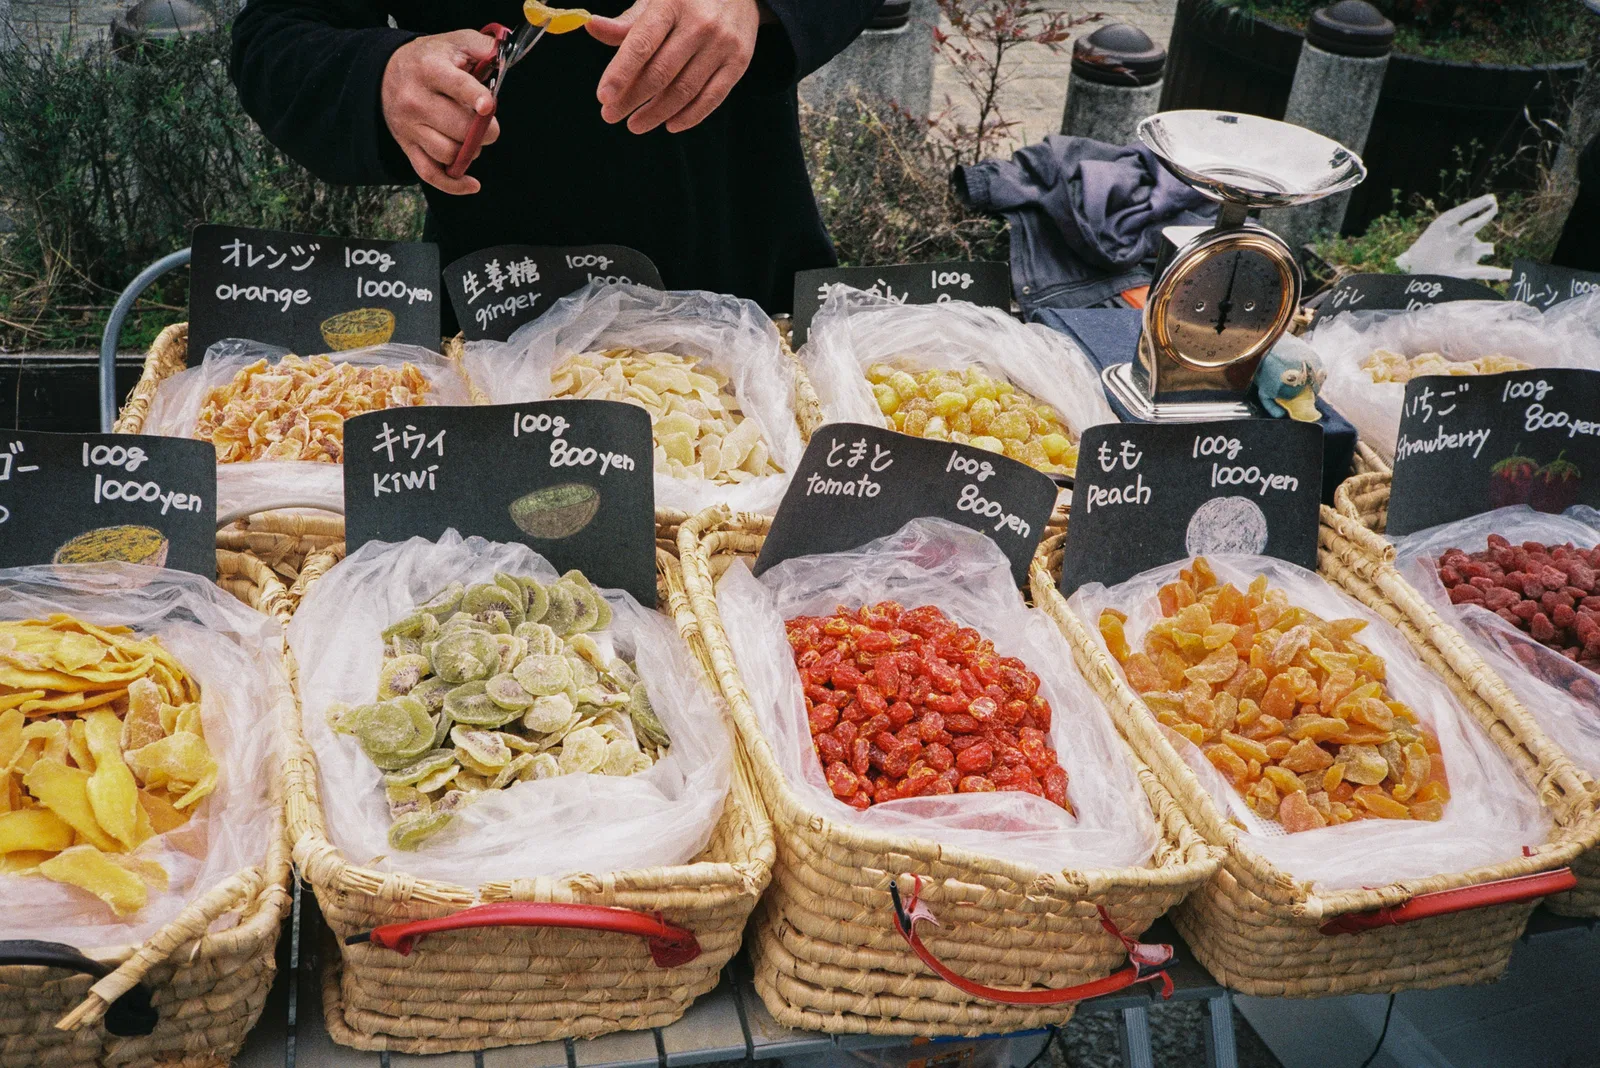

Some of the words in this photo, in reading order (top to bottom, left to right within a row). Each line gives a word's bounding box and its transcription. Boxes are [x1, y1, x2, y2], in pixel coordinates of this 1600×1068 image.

[220, 238, 320, 271] オレンジ
[344, 247, 396, 272] 100g
[565, 255, 614, 271] 100g
[462, 256, 540, 304] 生姜糖
[931, 270, 974, 289] 100g
[1404, 279, 1443, 299] 100g
[1513, 272, 1559, 306] プルーン
[215, 283, 311, 312] orange
[475, 292, 542, 331] ginger
[1332, 286, 1365, 308] なし
[1405, 382, 1470, 423] いちご
[1502, 379, 1554, 403] 100g
[513, 412, 570, 437] 100g
[82, 442, 148, 472] 100g
[826, 438, 893, 472] とまと
[1097, 440, 1143, 472] もも
[1192, 435, 1243, 460] 100g
[945, 450, 996, 482] 100g
[806, 472, 881, 498] tomato
[1087, 474, 1152, 513] peach
